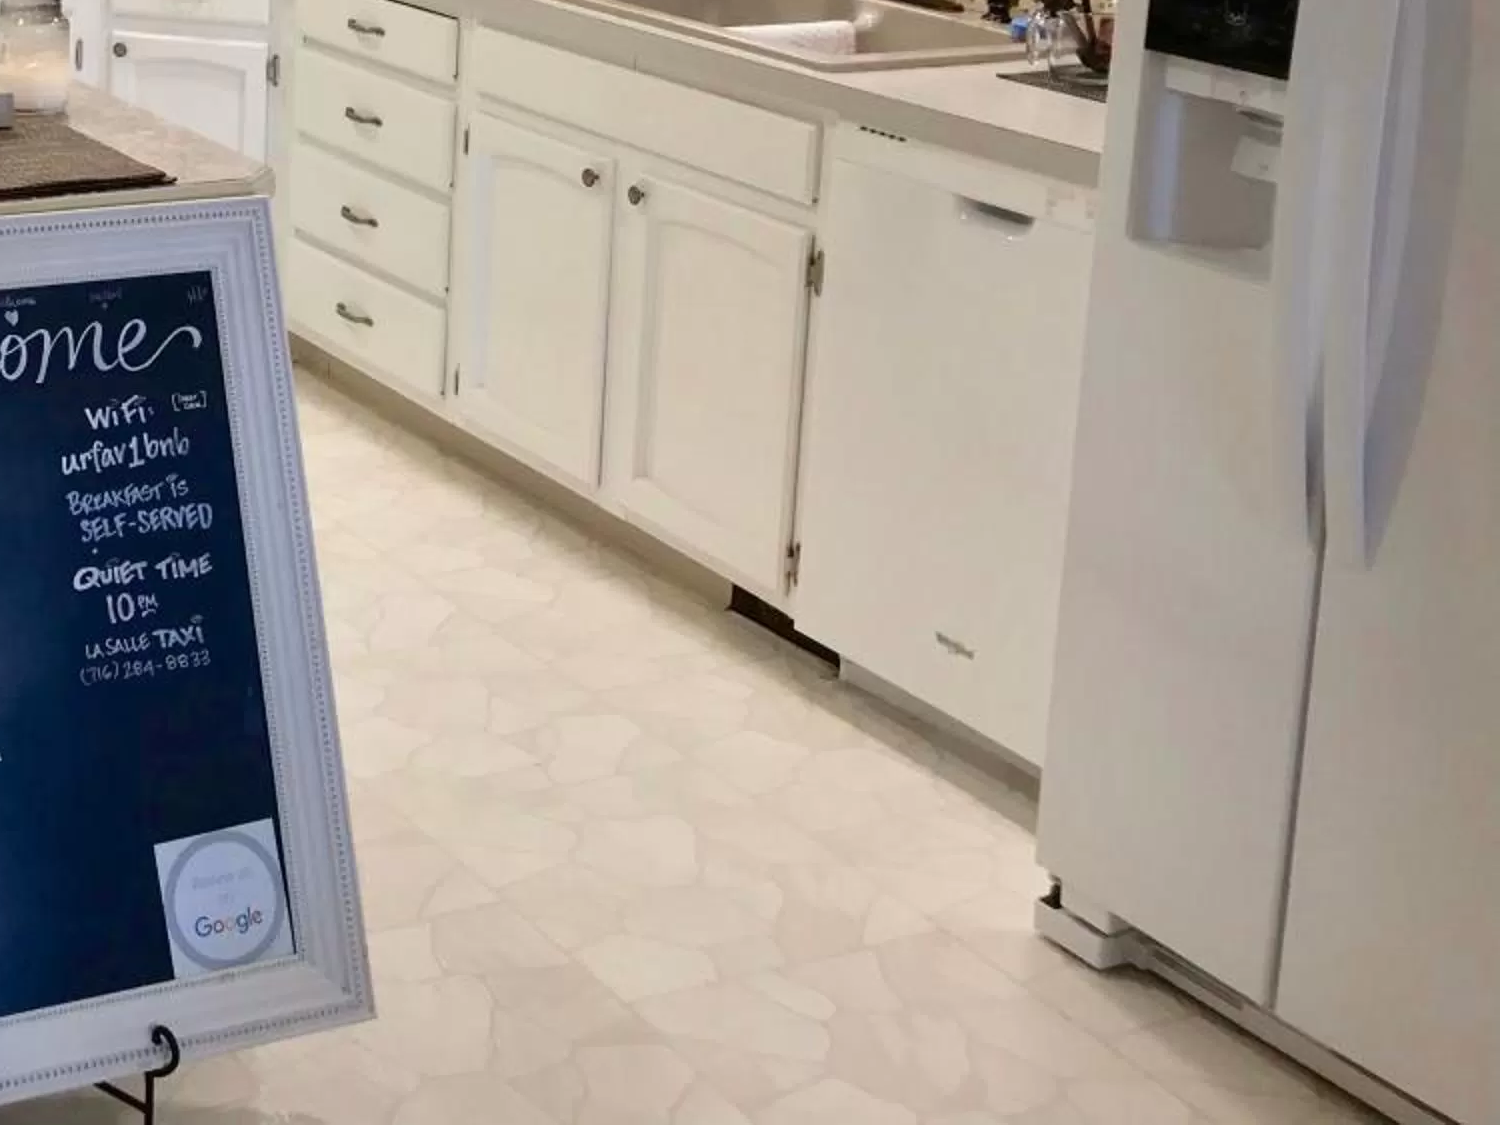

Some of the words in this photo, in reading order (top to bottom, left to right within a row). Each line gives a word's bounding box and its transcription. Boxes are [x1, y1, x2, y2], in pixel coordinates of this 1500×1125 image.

[61, 426, 190, 475] urfav1bnb
[65, 481, 164, 516] BREAKFAST
[80, 503, 213, 542] SELF-SERVED
[73, 557, 148, 591] QUIET
[154, 552, 213, 580] TIME
[195, 906, 263, 938] Google
